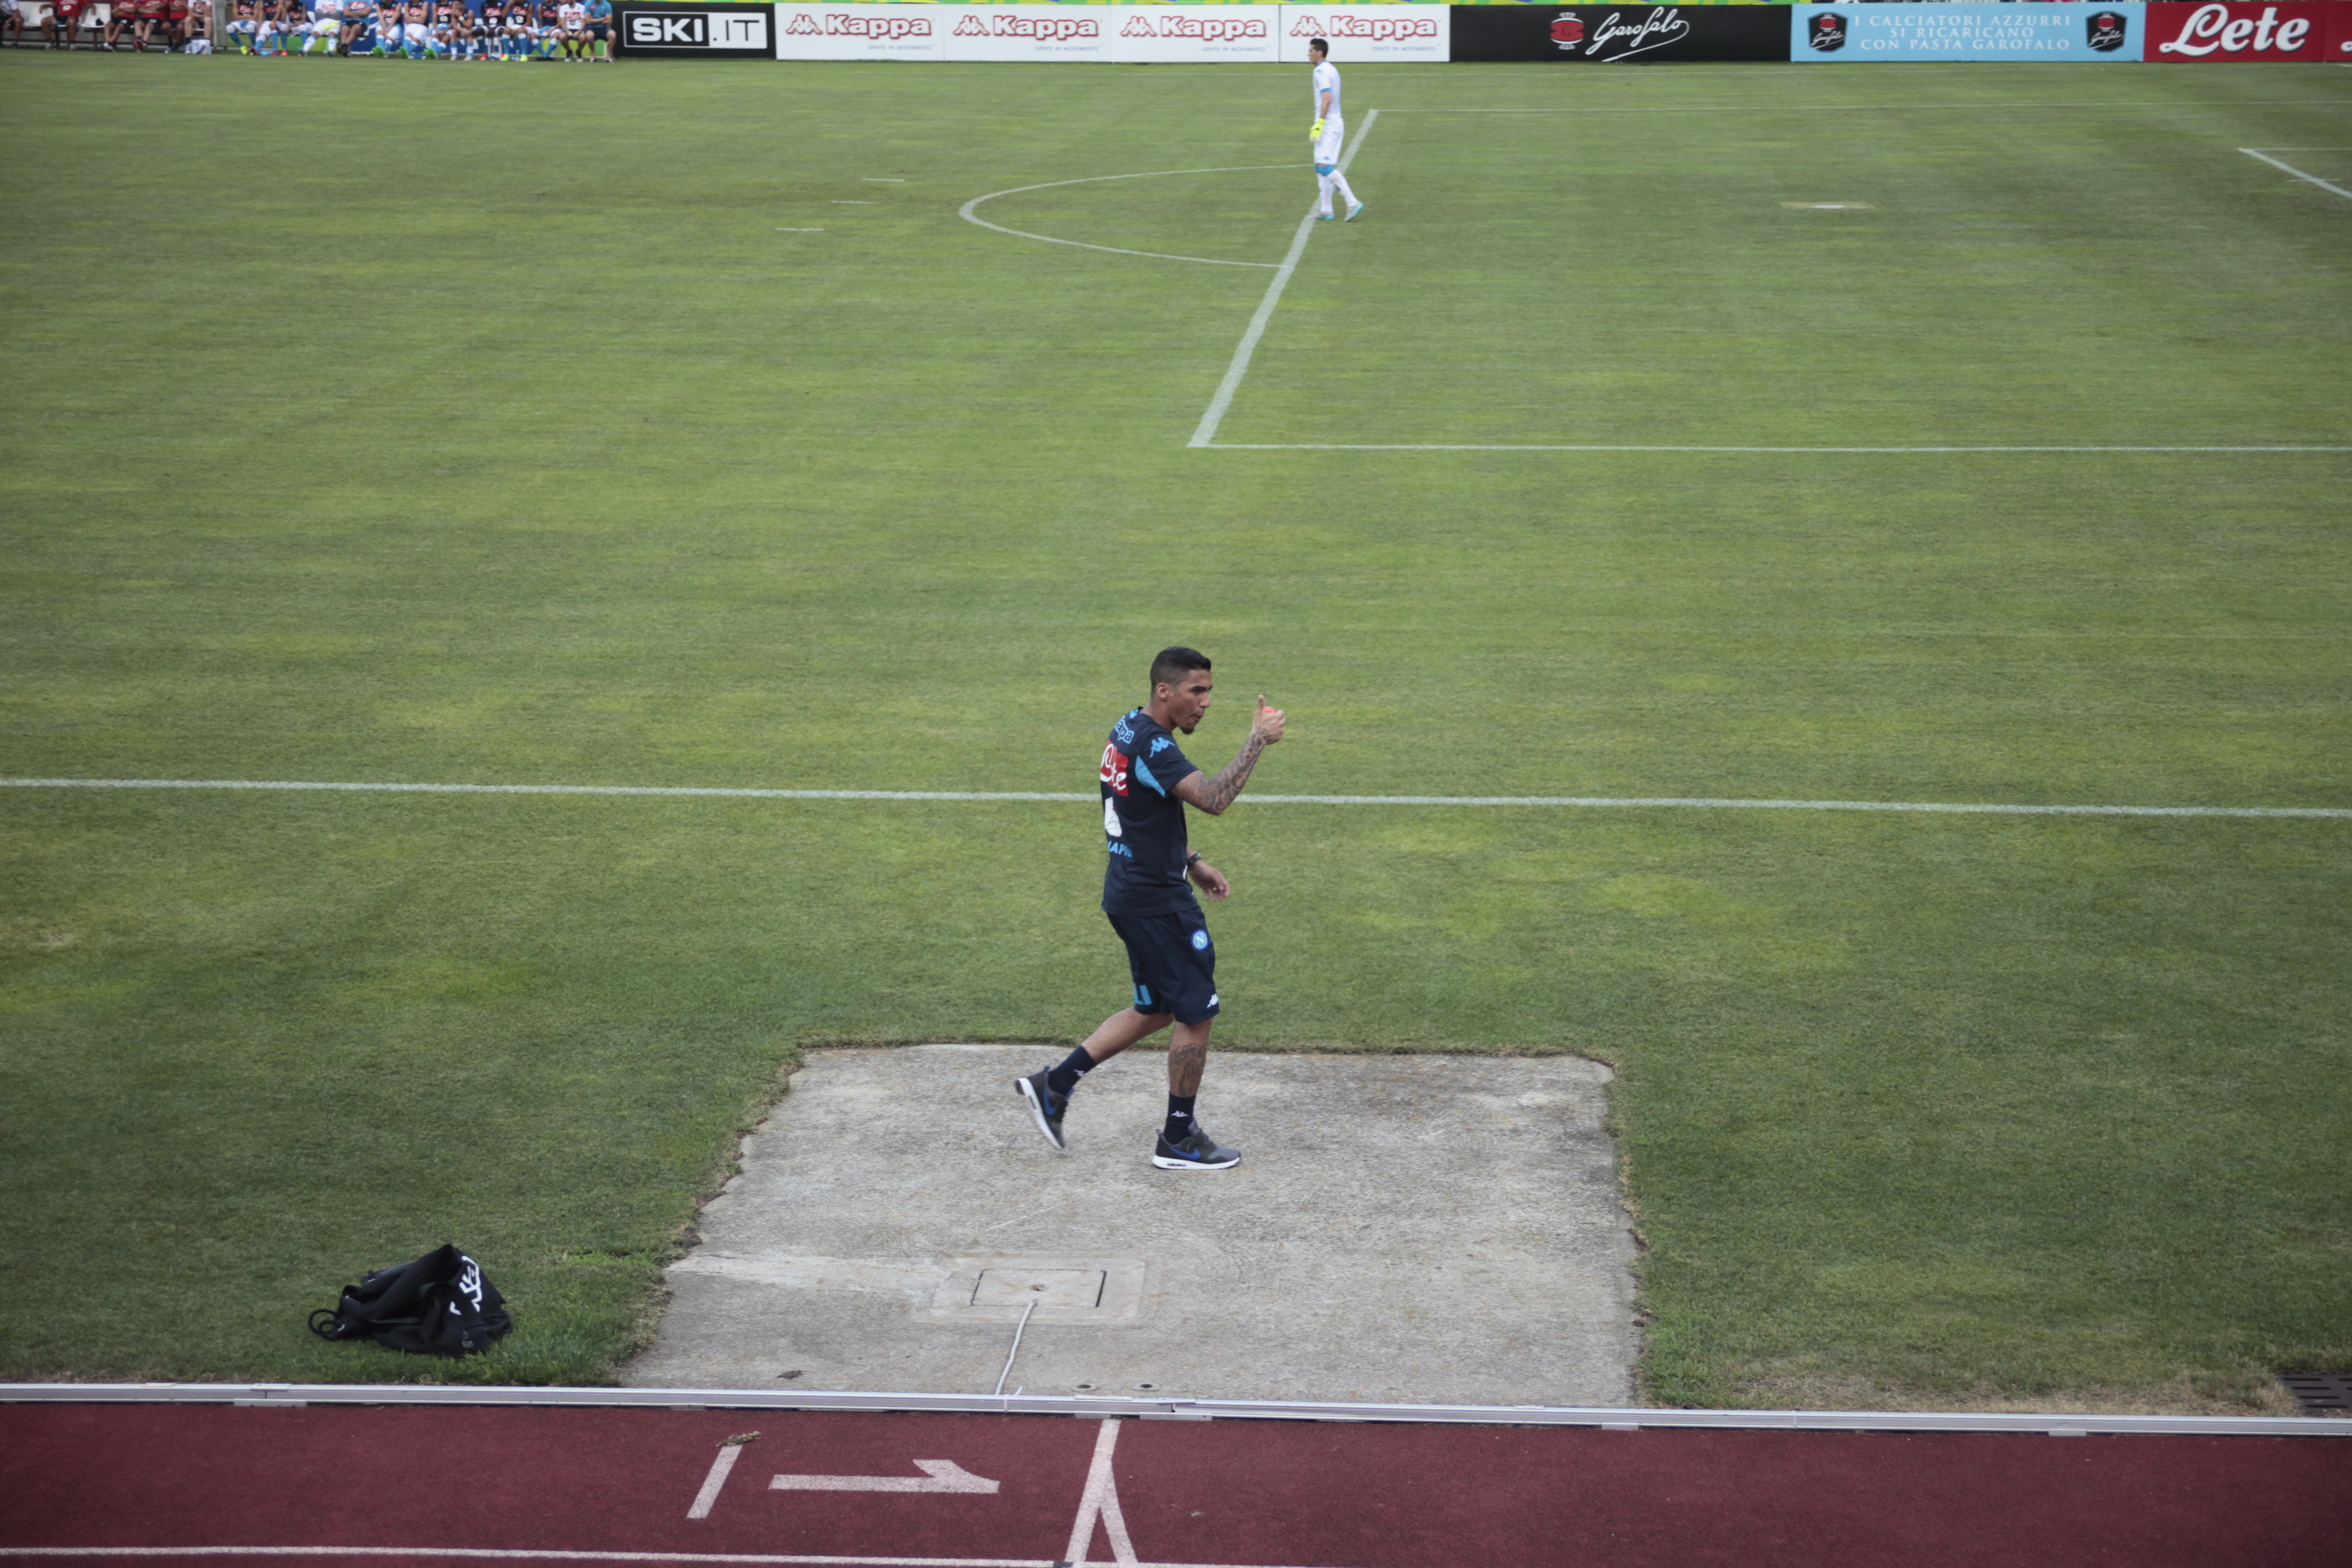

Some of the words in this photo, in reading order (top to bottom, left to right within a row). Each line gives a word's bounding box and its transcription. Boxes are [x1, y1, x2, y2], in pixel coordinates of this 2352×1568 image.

[632, 18, 760, 42] SKI.IT
[826, 14, 931, 39] Kappa
[993, 16, 1098, 40] Kappa
[1161, 16, 1266, 41] Kappa
[1331, 15, 1436, 41] Kappa
[1854, 15, 1860, 26] I
[1869, 15, 1981, 26] CALCIATORI
[1990, 15, 2070, 26] AZZURRI
[1890, 27, 1906, 38] SI
[1916, 27, 2034, 38] RICARICANO
[2159, 3, 2309, 57] Lete
[1585, 6, 1689, 62] Garofalo
[1860, 39, 1900, 50] CON
[1910, 39, 1963, 49] PASTA
[1972, 39, 2069, 50] GAROFALO
[1100, 744, 1127, 790] Lte
[1195, 934, 1204, 946] N
